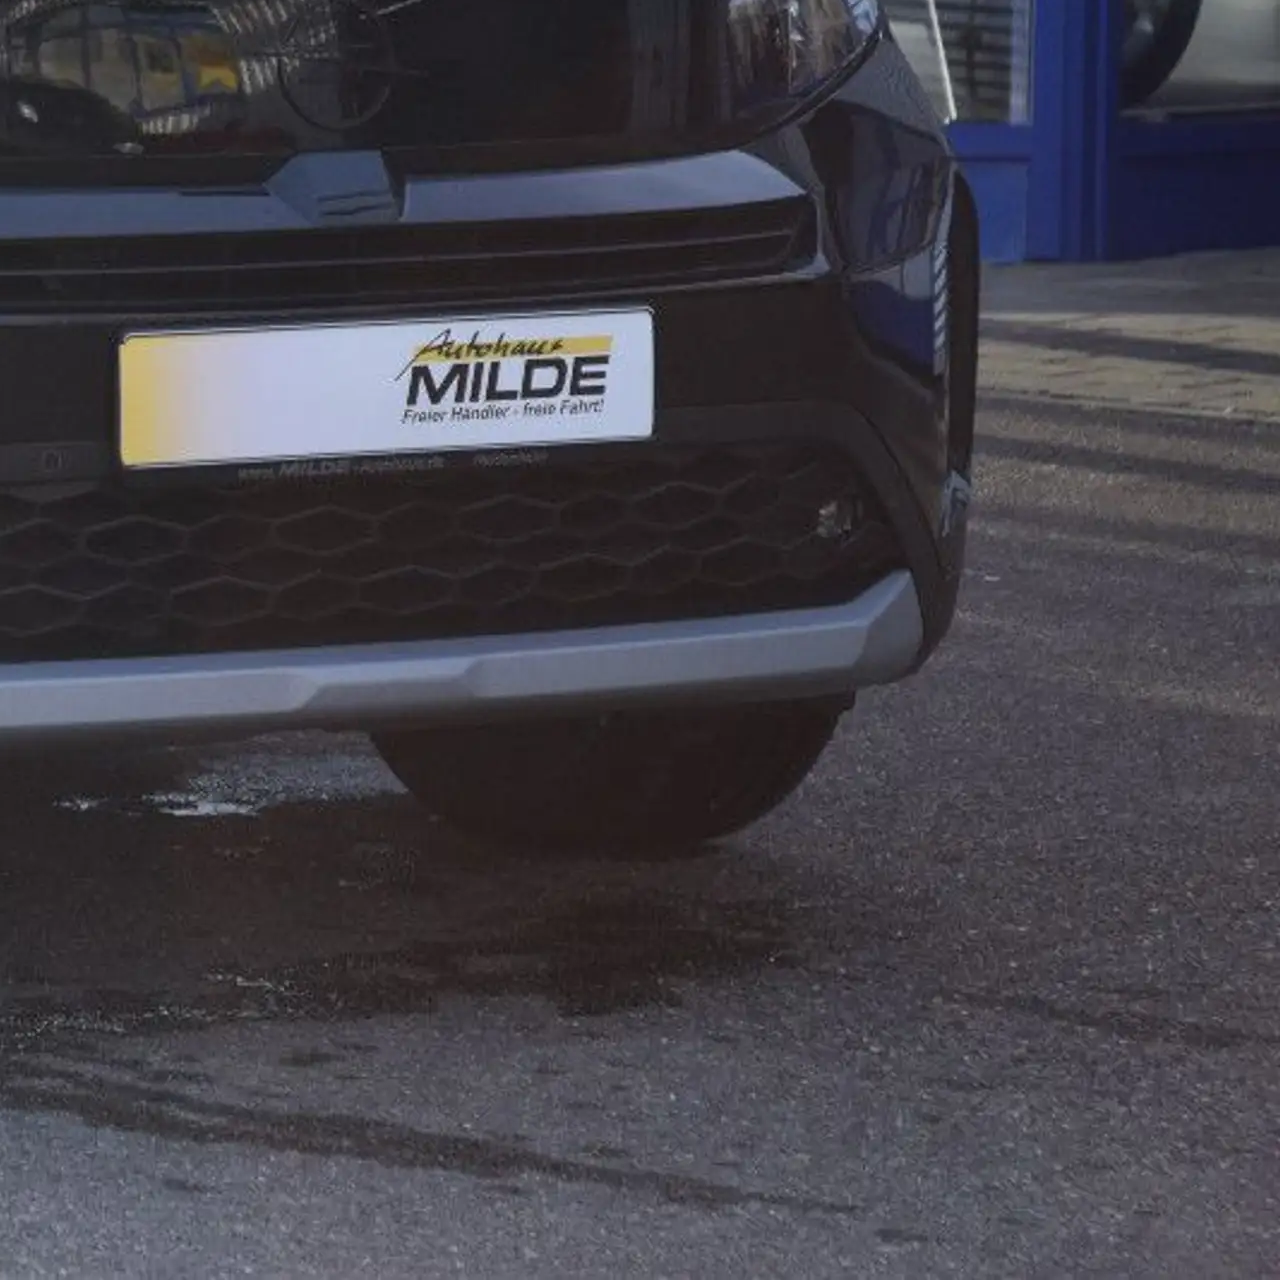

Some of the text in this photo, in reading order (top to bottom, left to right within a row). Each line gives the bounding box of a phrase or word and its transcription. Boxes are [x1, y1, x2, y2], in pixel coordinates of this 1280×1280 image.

[394, 328, 565, 381] Autohaus
[406, 355, 611, 406] MILDE
[402, 408, 447, 425] Freier
